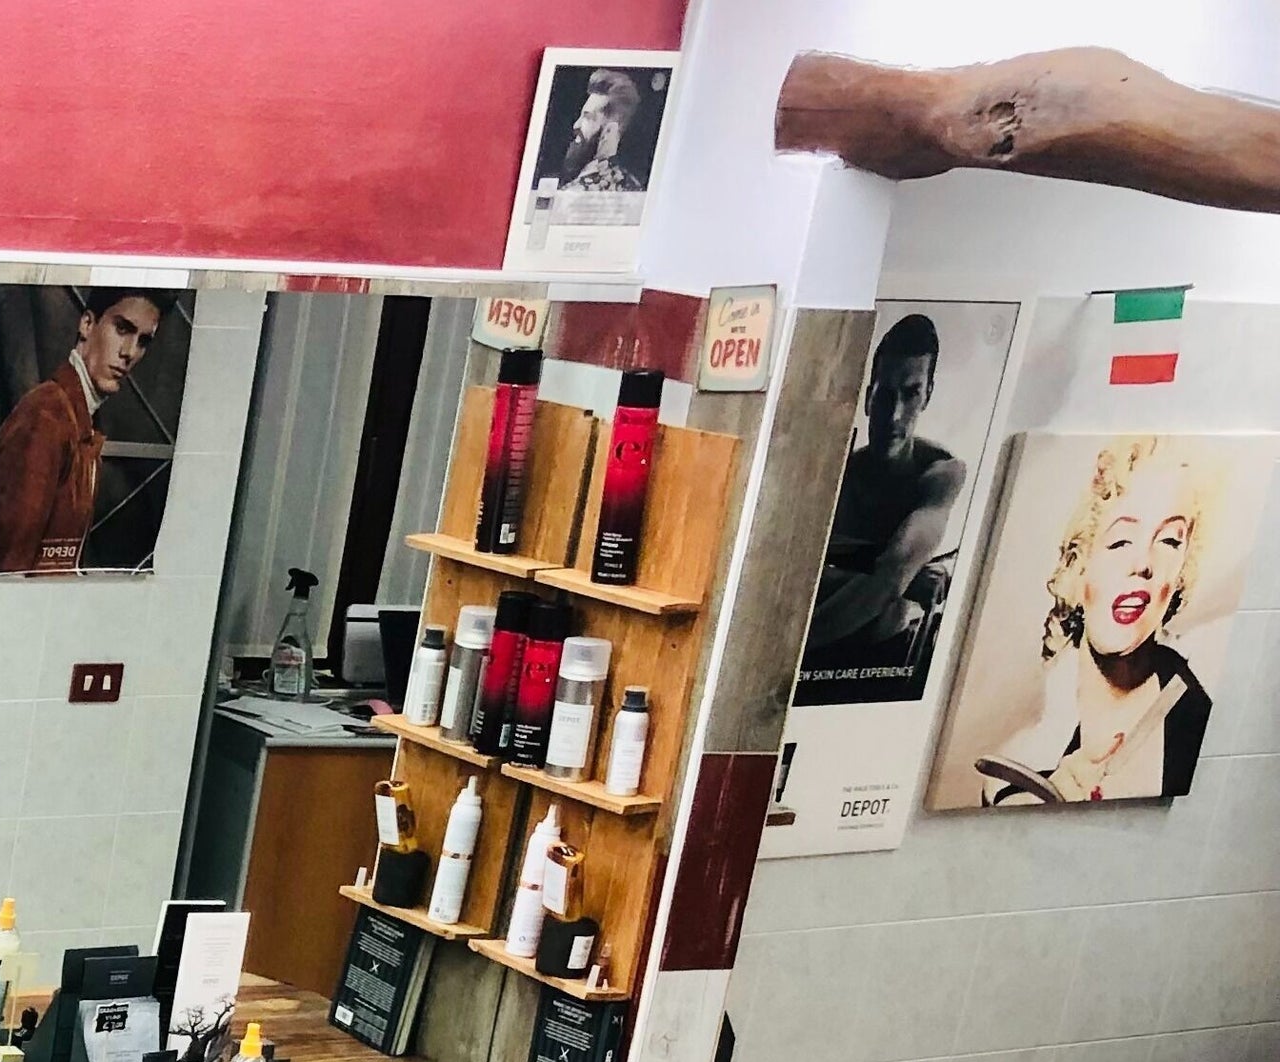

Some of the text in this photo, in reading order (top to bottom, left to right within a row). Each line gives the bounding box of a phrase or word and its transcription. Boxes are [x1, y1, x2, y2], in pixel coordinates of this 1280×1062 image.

[710, 338, 761, 369] OPEN
[798, 665, 915, 682] EW SKIN CARE EXPERIENCE
[841, 798, 891, 818] DEPOT
